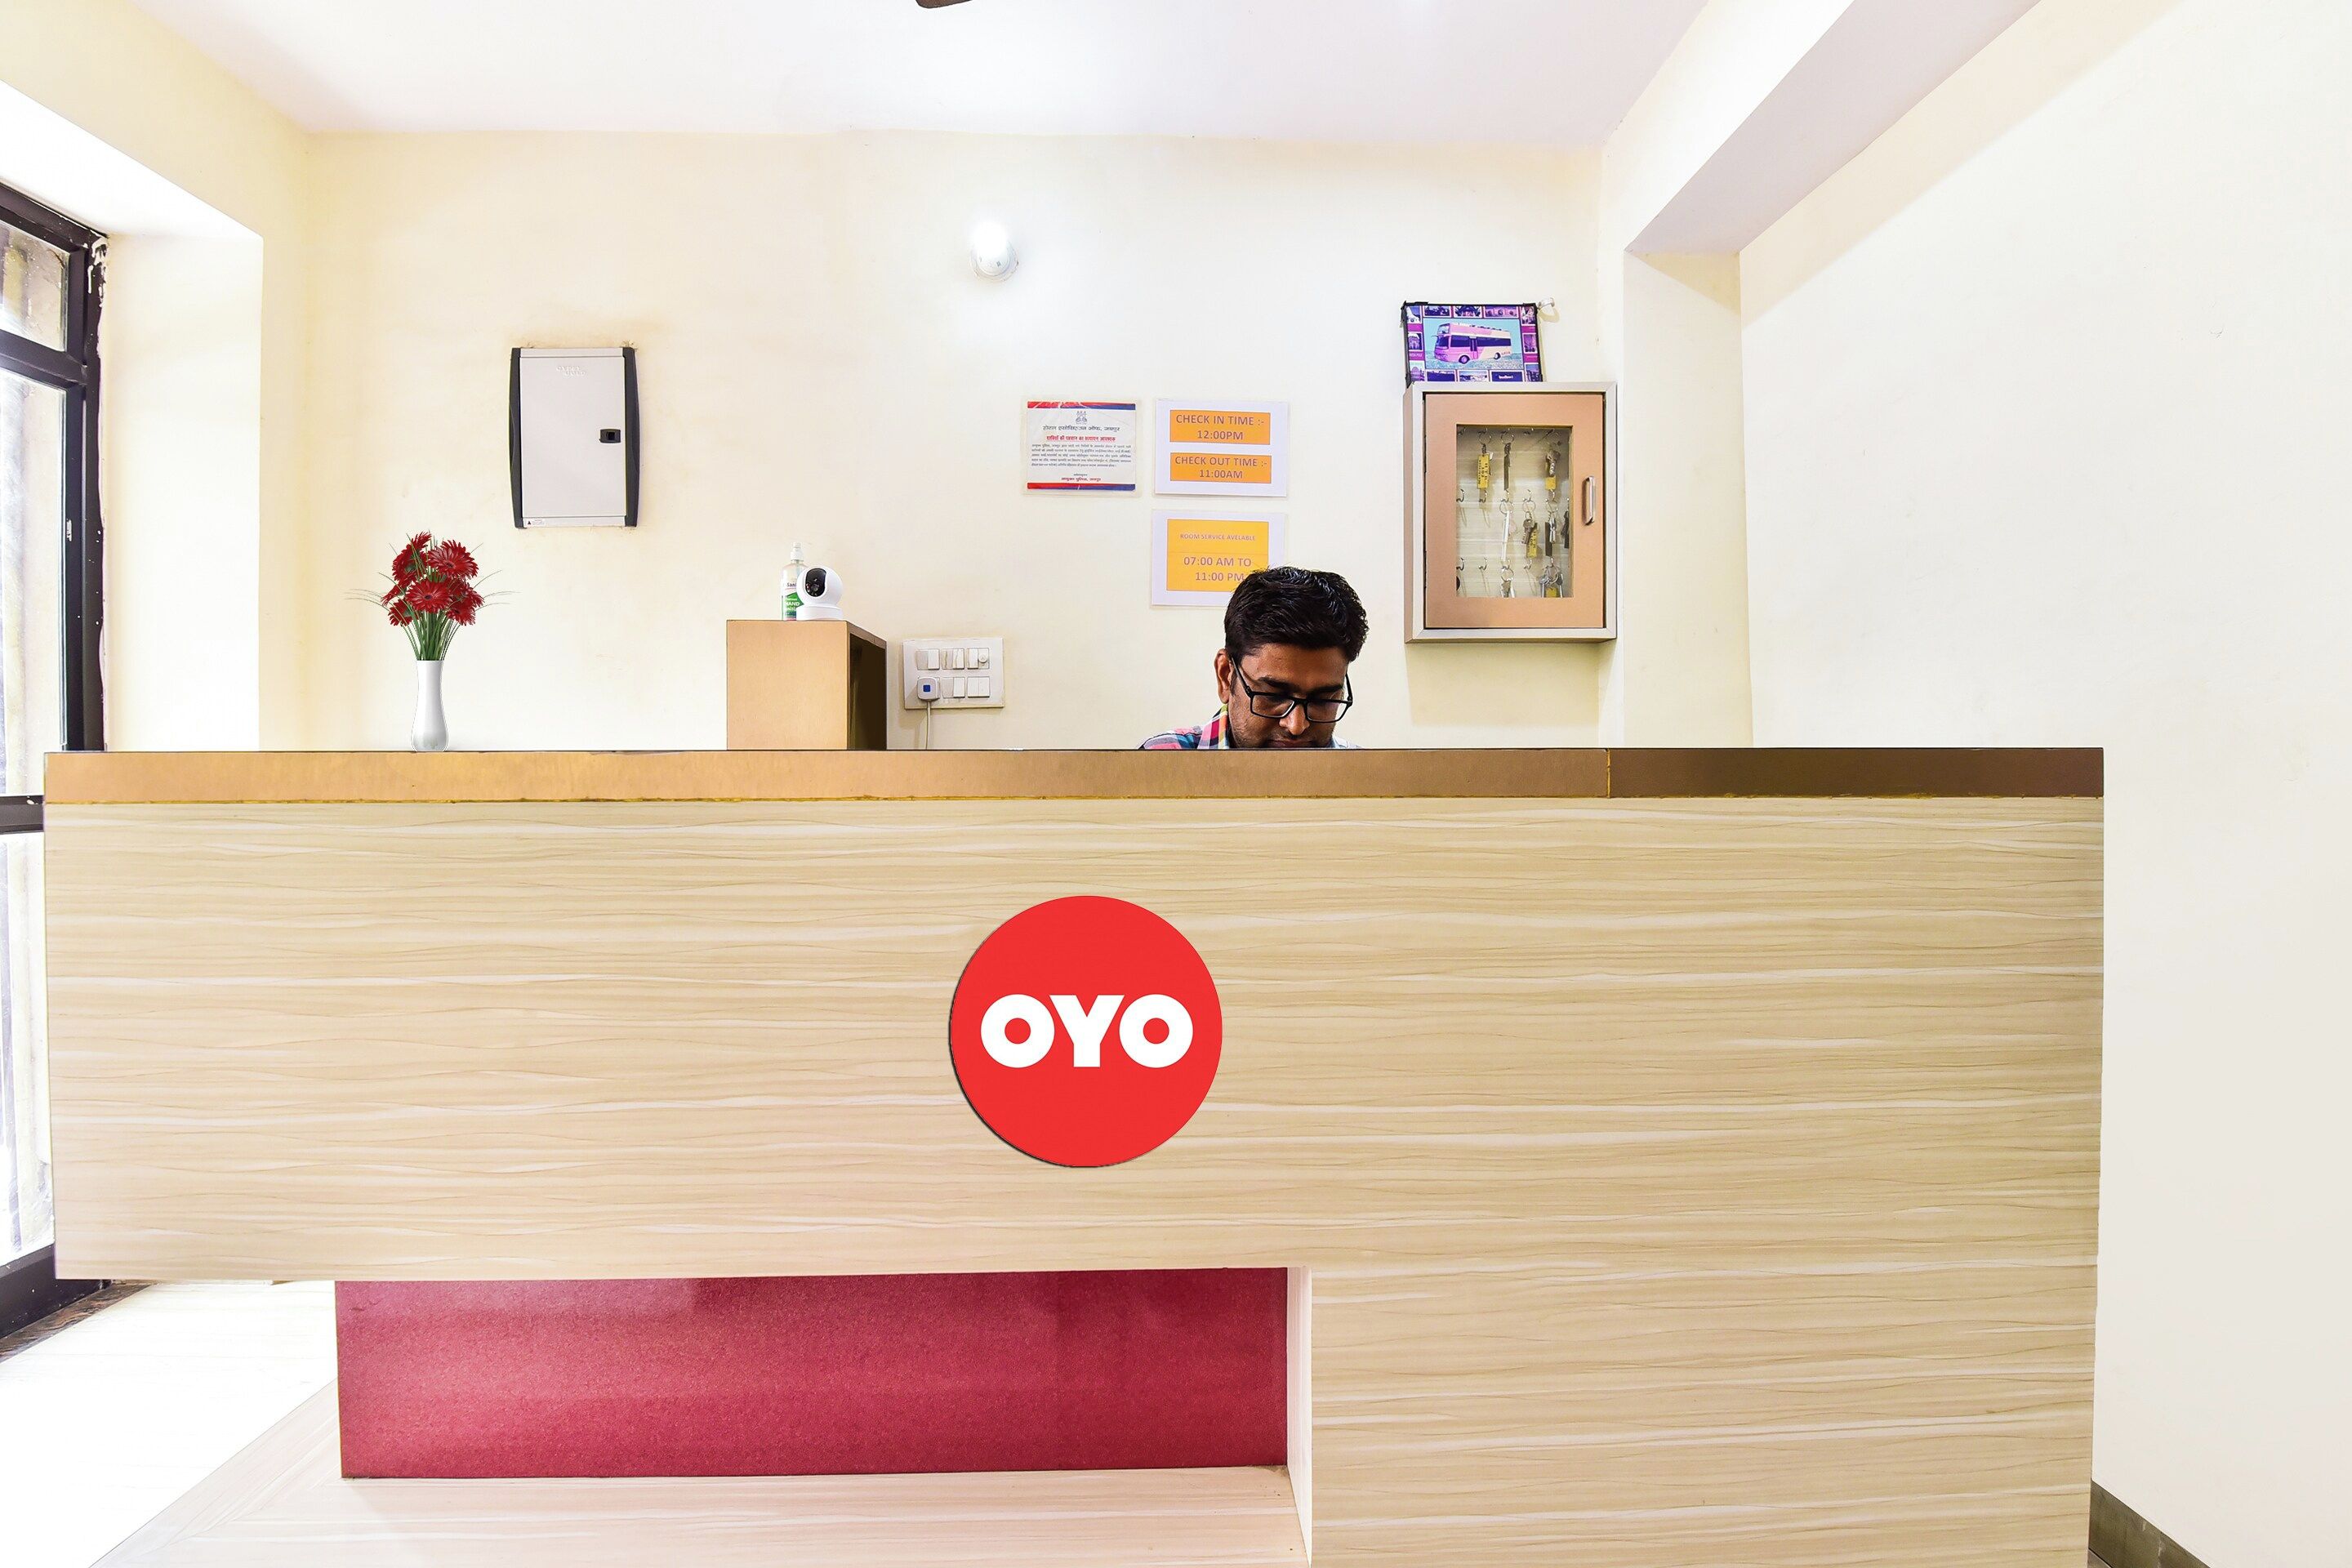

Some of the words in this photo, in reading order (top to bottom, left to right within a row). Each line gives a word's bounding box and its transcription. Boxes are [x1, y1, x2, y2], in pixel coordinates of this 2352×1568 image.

[1176, 414, 1209, 424] CHECK
[1214, 415, 1224, 425] IN
[1227, 416, 1254, 425] TIME
[1197, 430, 1243, 440] 12:00PM
[1175, 456, 1206, 465] CHECK
[1209, 457, 1230, 466] OUT
[1234, 457, 1258, 466] TIME
[1200, 470, 1243, 479] 11:00AM
[1183, 557, 1213, 566] 07:00
[1216, 558, 1234, 566] AM
[1238, 558, 1251, 567] TO
[1196, 572, 1223, 581] 11:00
[1227, 572, 1245, 581] PM
[981, 994, 1194, 1068] OYO
